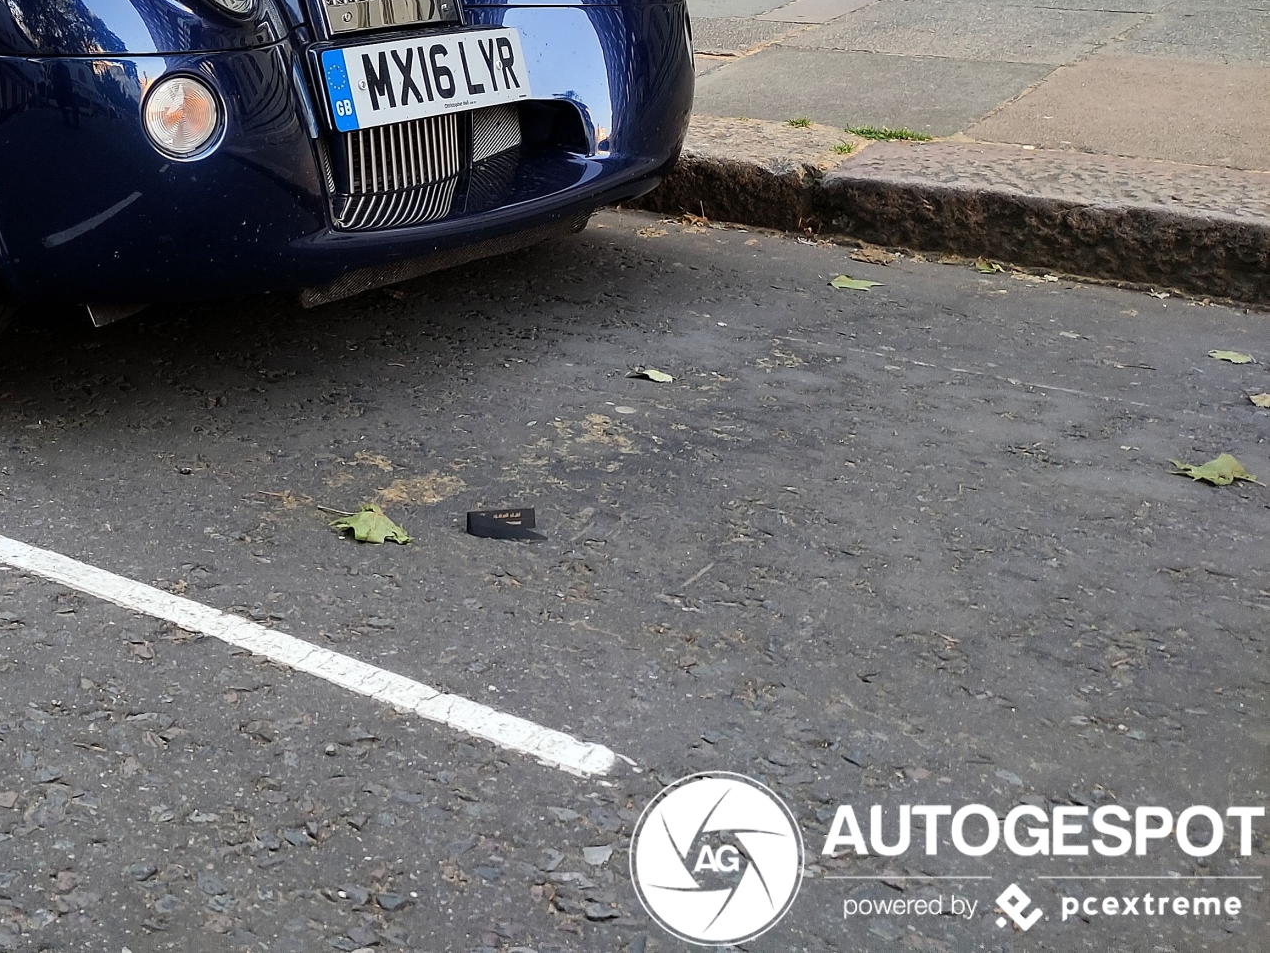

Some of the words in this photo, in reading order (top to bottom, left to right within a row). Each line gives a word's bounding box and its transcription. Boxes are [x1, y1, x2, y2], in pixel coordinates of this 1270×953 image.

[361, 44, 456, 111] MX16
[458, 37, 521, 95] LYR
[335, 98, 353, 117] GB
